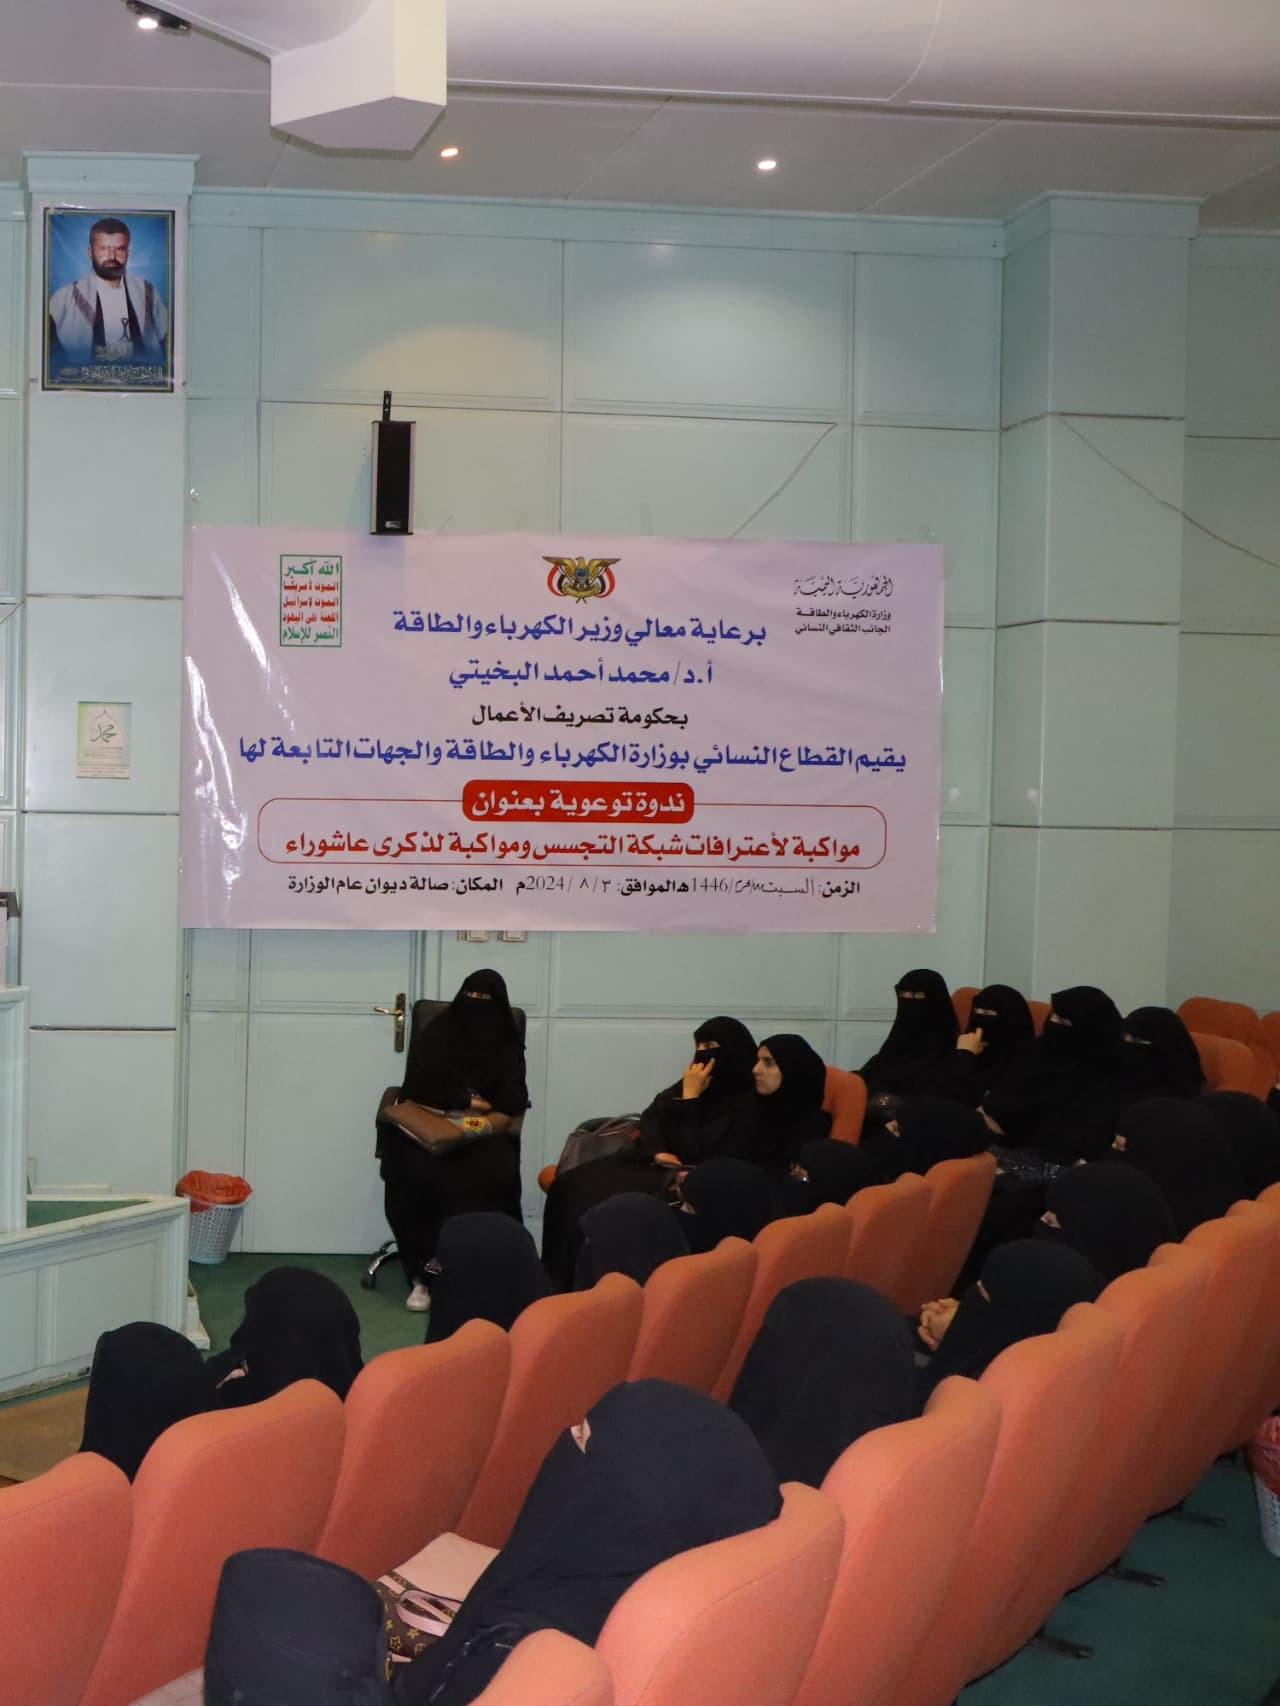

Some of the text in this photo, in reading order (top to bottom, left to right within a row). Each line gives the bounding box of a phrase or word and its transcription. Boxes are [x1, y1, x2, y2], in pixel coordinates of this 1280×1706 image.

[318, 560, 339, 575] الله
[796, 607, 891, 621] وزارة الكهرباء والطاقة
[393, 611, 767, 647] برعاية معالي وزير الكهرباء والطاقة
[828, 623, 860, 636] الثقافي
[861, 624, 891, 636] الجانب
[449, 659, 539, 689] البخيتي
[543, 657, 604, 684] أحمد
[608, 666, 670, 684] محمد
[472, 701, 688, 729] بحكومة تصريف الأعمال
[239, 736, 907, 773] يقيم القطاع النسائي بوزارة الكهرباء والطاقة والجهات التابعة لها
[472, 789, 685, 818] ندوة توعوية بعنوان
[286, 830, 369, 857] عاشوراء
[373, 831, 445, 858] لذكرى
[447, 831, 531, 860] ومواكبة
[532, 834, 623, 860] التجسس
[627, 834, 684, 861] شبكة
[792, 835, 860, 863] مواكبة
[288, 875, 335, 894] الوزارة
[336, 876, 362, 894] عام
[365, 877, 408, 894] ديوان
[410, 876, 449, 891] صالة
[451, 876, 503, 894] المكان:
[817, 881, 860, 898] الزمن:
